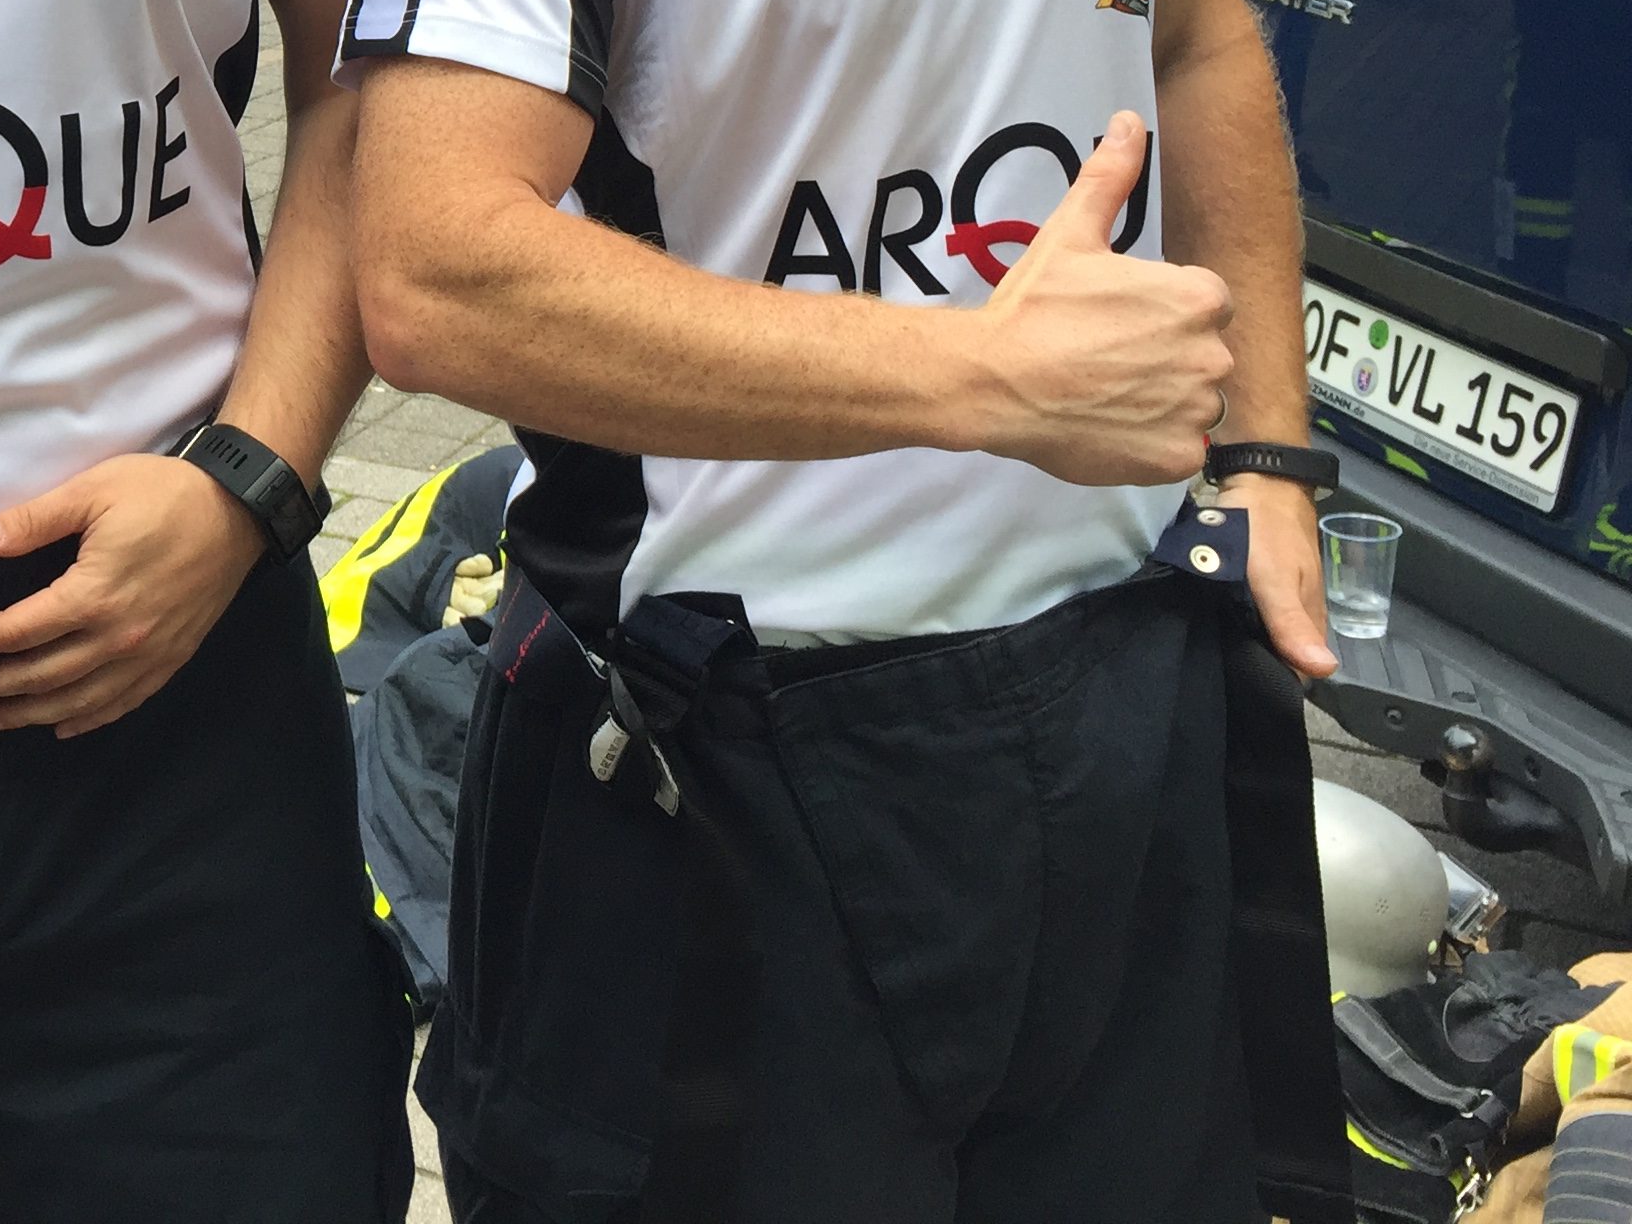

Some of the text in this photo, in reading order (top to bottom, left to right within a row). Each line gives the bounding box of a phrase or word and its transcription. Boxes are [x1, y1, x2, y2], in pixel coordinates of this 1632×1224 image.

[762, 121, 1154, 297] ARQU
[1312, 384, 1366, 419] ZMANN.de
[1388, 335, 1445, 426] VL
[1455, 371, 1568, 472] 159
